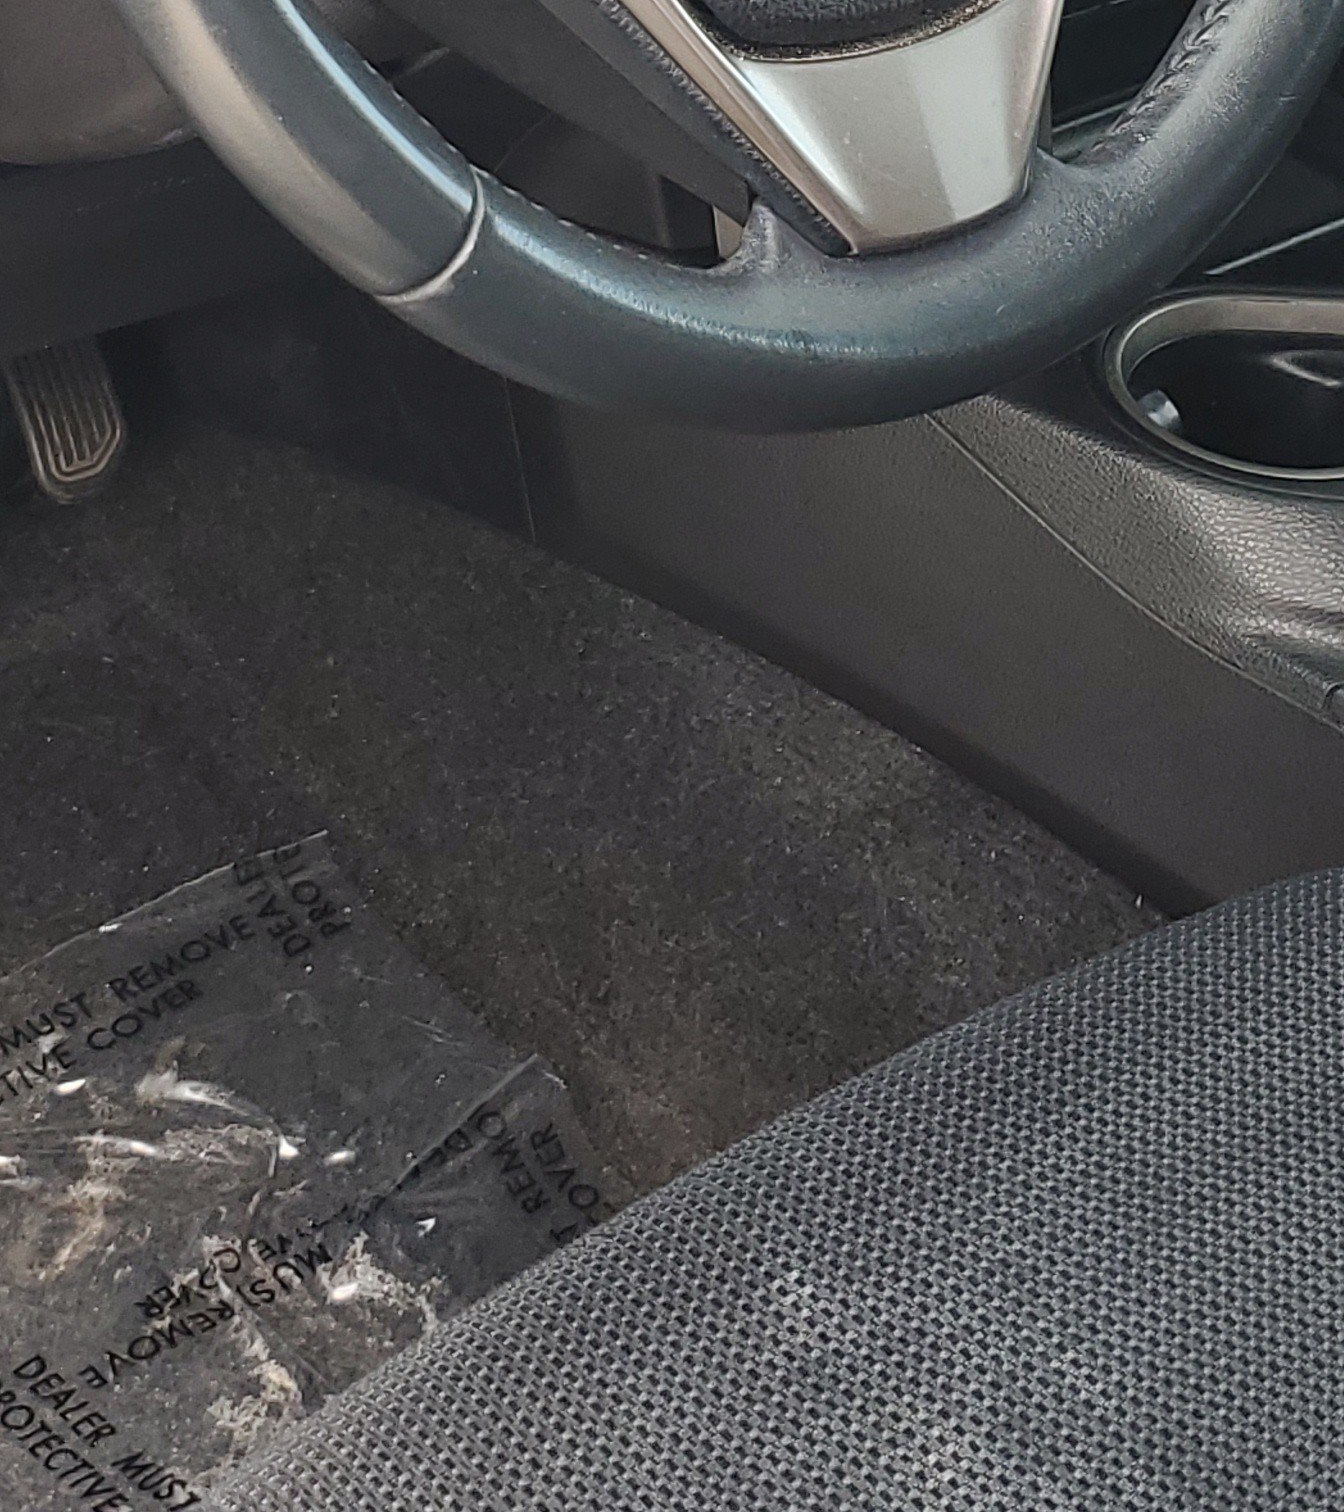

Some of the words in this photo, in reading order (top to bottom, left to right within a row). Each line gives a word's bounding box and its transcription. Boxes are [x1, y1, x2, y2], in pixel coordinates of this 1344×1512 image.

[108, 913, 257, 1002] REMOVE
[86, 977, 205, 1053] COVER
[77, 1299, 236, 1389] REMOVE
[12, 1354, 117, 1449] DEALER
[110, 1449, 203, 1512] MUST
